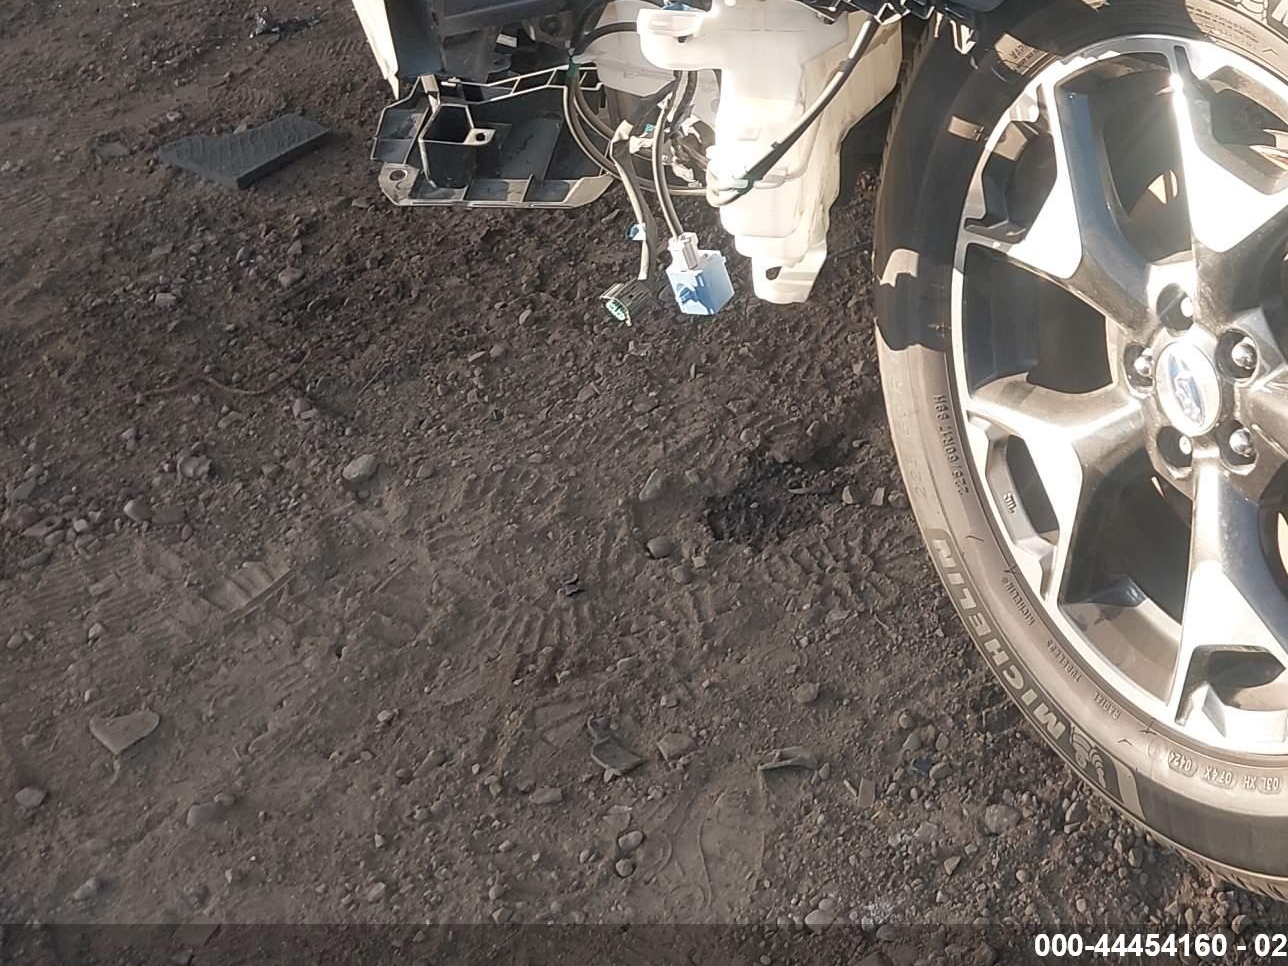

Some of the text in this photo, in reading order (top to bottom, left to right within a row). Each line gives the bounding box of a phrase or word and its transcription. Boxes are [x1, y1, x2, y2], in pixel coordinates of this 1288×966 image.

[932, 535, 1067, 737] MICHELIN
[1167, 750, 1193, 772] 0424
[1243, 775, 1257, 790] XH
